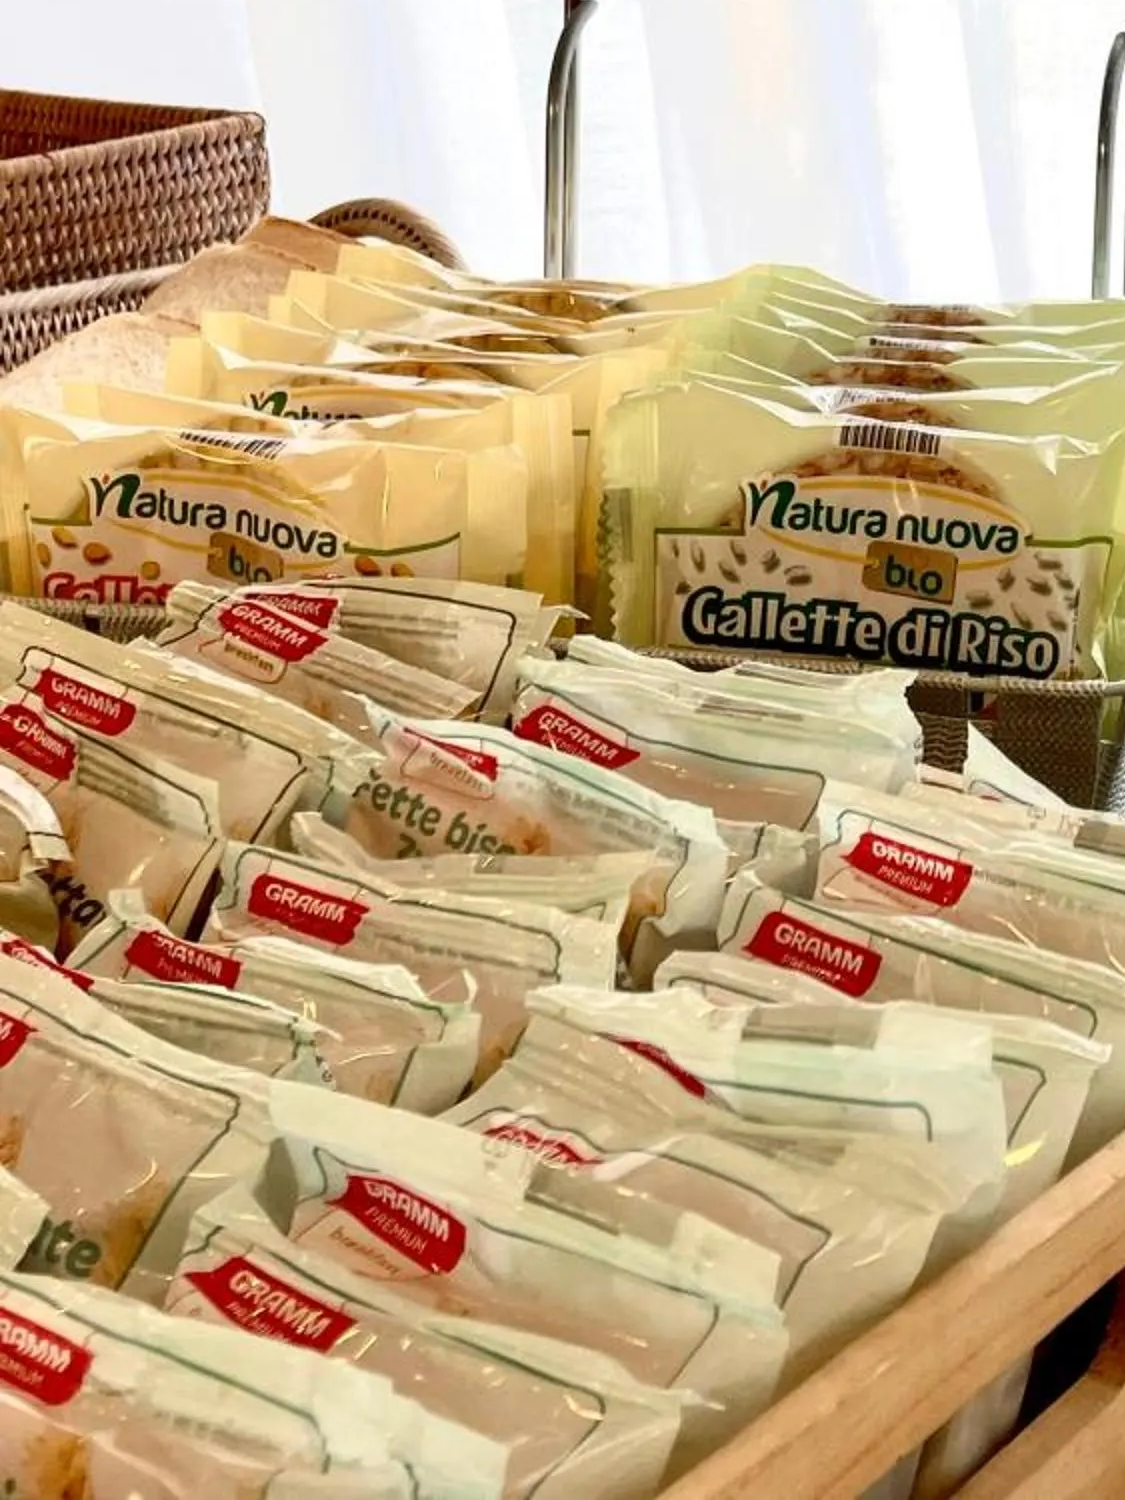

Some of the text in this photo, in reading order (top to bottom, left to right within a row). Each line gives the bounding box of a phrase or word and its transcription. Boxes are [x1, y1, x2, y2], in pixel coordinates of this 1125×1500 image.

[235, 509, 338, 558] nuova
[896, 513, 1019, 553] nuova
[884, 554, 944, 596] bio
[231, 606, 309, 648] GRAMM
[687, 588, 1056, 675] Gallette di Riso
[51, 677, 122, 720] GRAMM
[538, 712, 619, 760] GRAMM
[871, 840, 956, 883] GRAMM
[265, 883, 347, 924] GRAMM
[773, 922, 865, 977] GRAMM
[363, 1180, 450, 1243] GRAMM
[229, 1269, 332, 1340] GRAMM
[0, 1317, 72, 1373] RAMM
